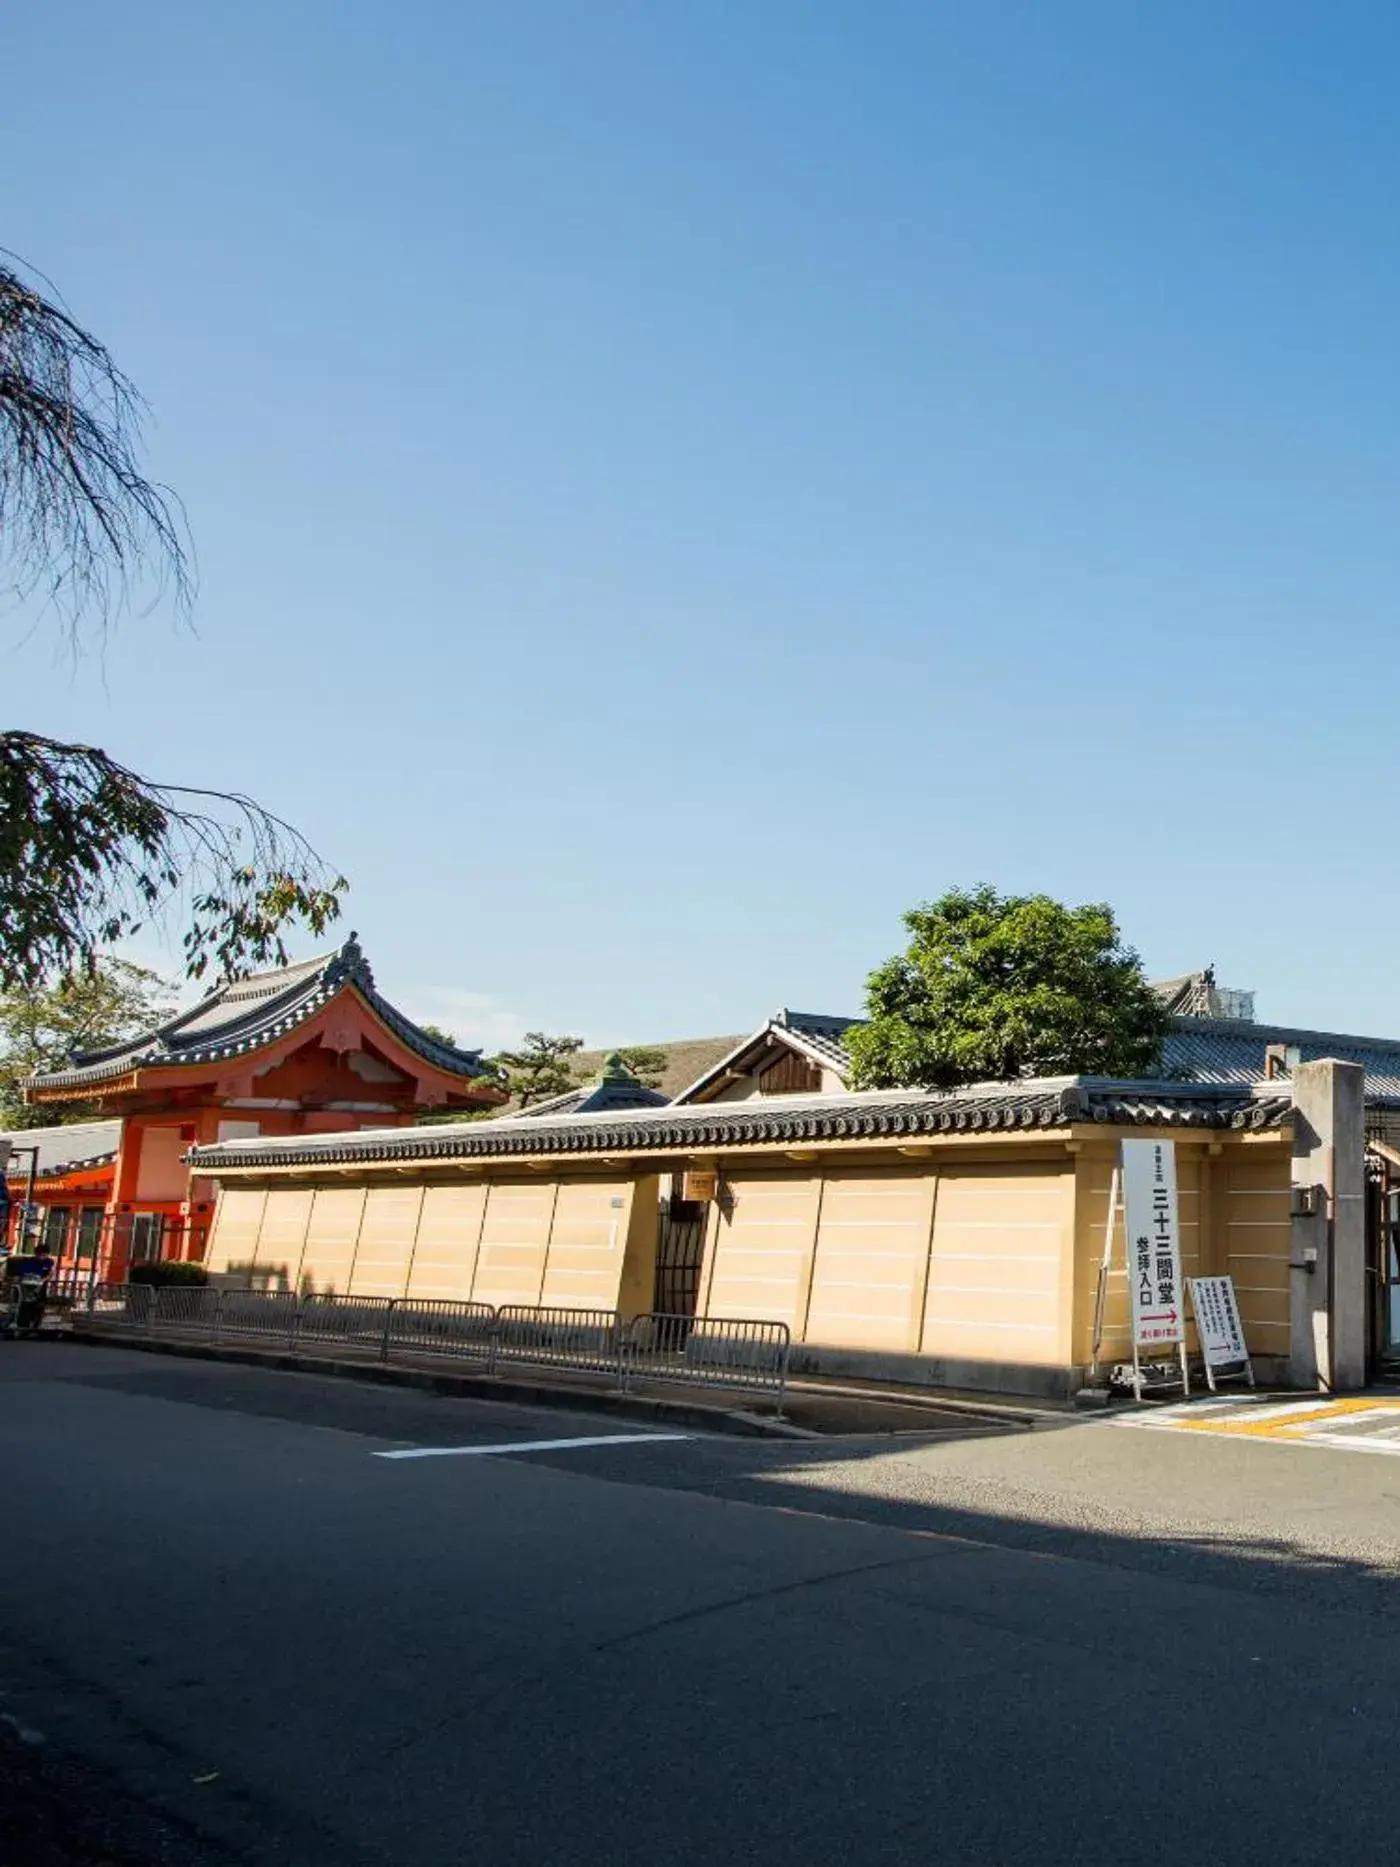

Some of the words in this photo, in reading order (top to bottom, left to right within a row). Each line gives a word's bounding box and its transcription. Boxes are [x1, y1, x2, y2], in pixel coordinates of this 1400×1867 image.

[1153, 1187, 1175, 1305] 三十三間堂
